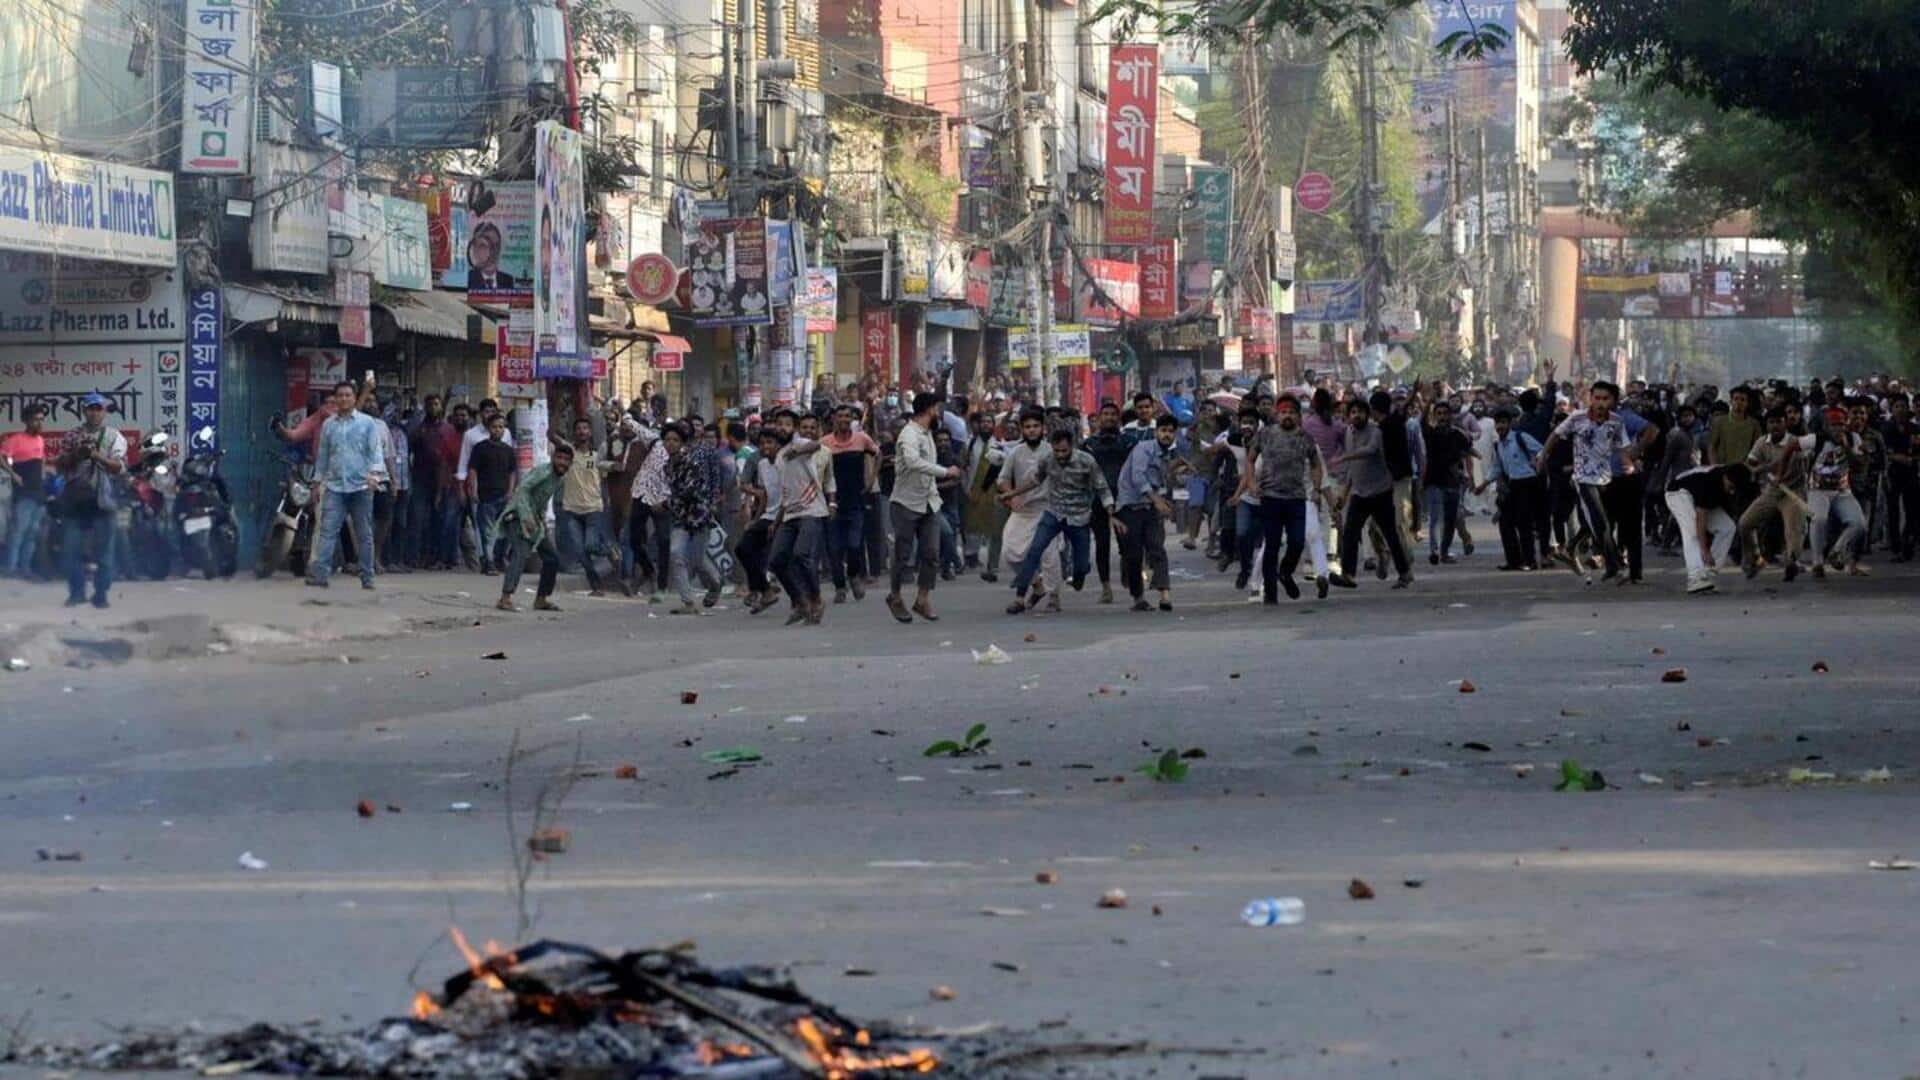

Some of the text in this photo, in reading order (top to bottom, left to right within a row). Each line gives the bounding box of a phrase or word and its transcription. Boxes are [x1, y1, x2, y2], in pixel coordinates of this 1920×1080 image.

[1468, 5, 1505, 20] CITY
[0, 160, 157, 238] azz Pharma Limited
[0, 307, 175, 332] Lazz Pharma Ltd.
